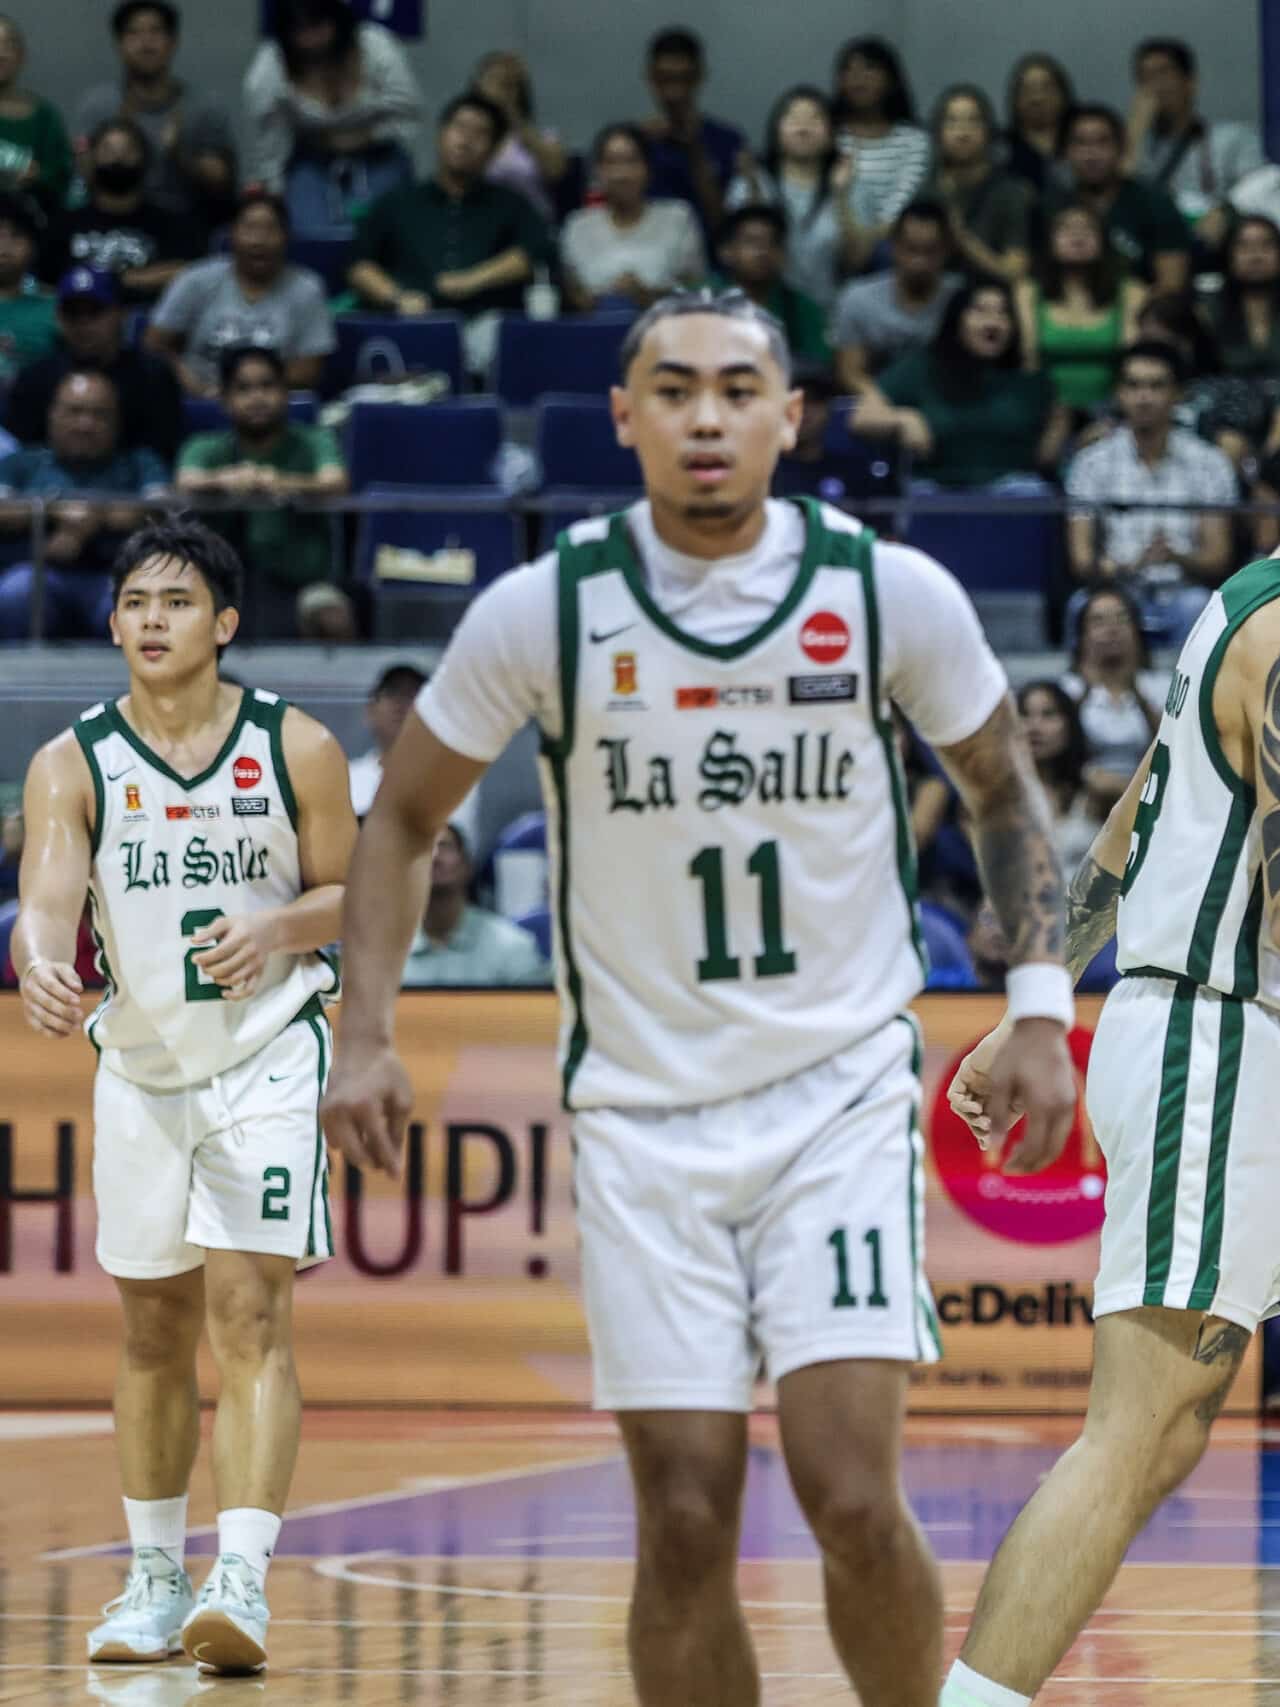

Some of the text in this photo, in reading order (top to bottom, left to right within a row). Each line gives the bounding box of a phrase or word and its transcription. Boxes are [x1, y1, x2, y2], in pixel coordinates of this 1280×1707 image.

[596, 729, 854, 814] La Salle
[119, 834, 270, 894] La Salle
[688, 840, 797, 983] 11
[261, 1166, 291, 1220] 2
[826, 1227, 888, 1308] 11
